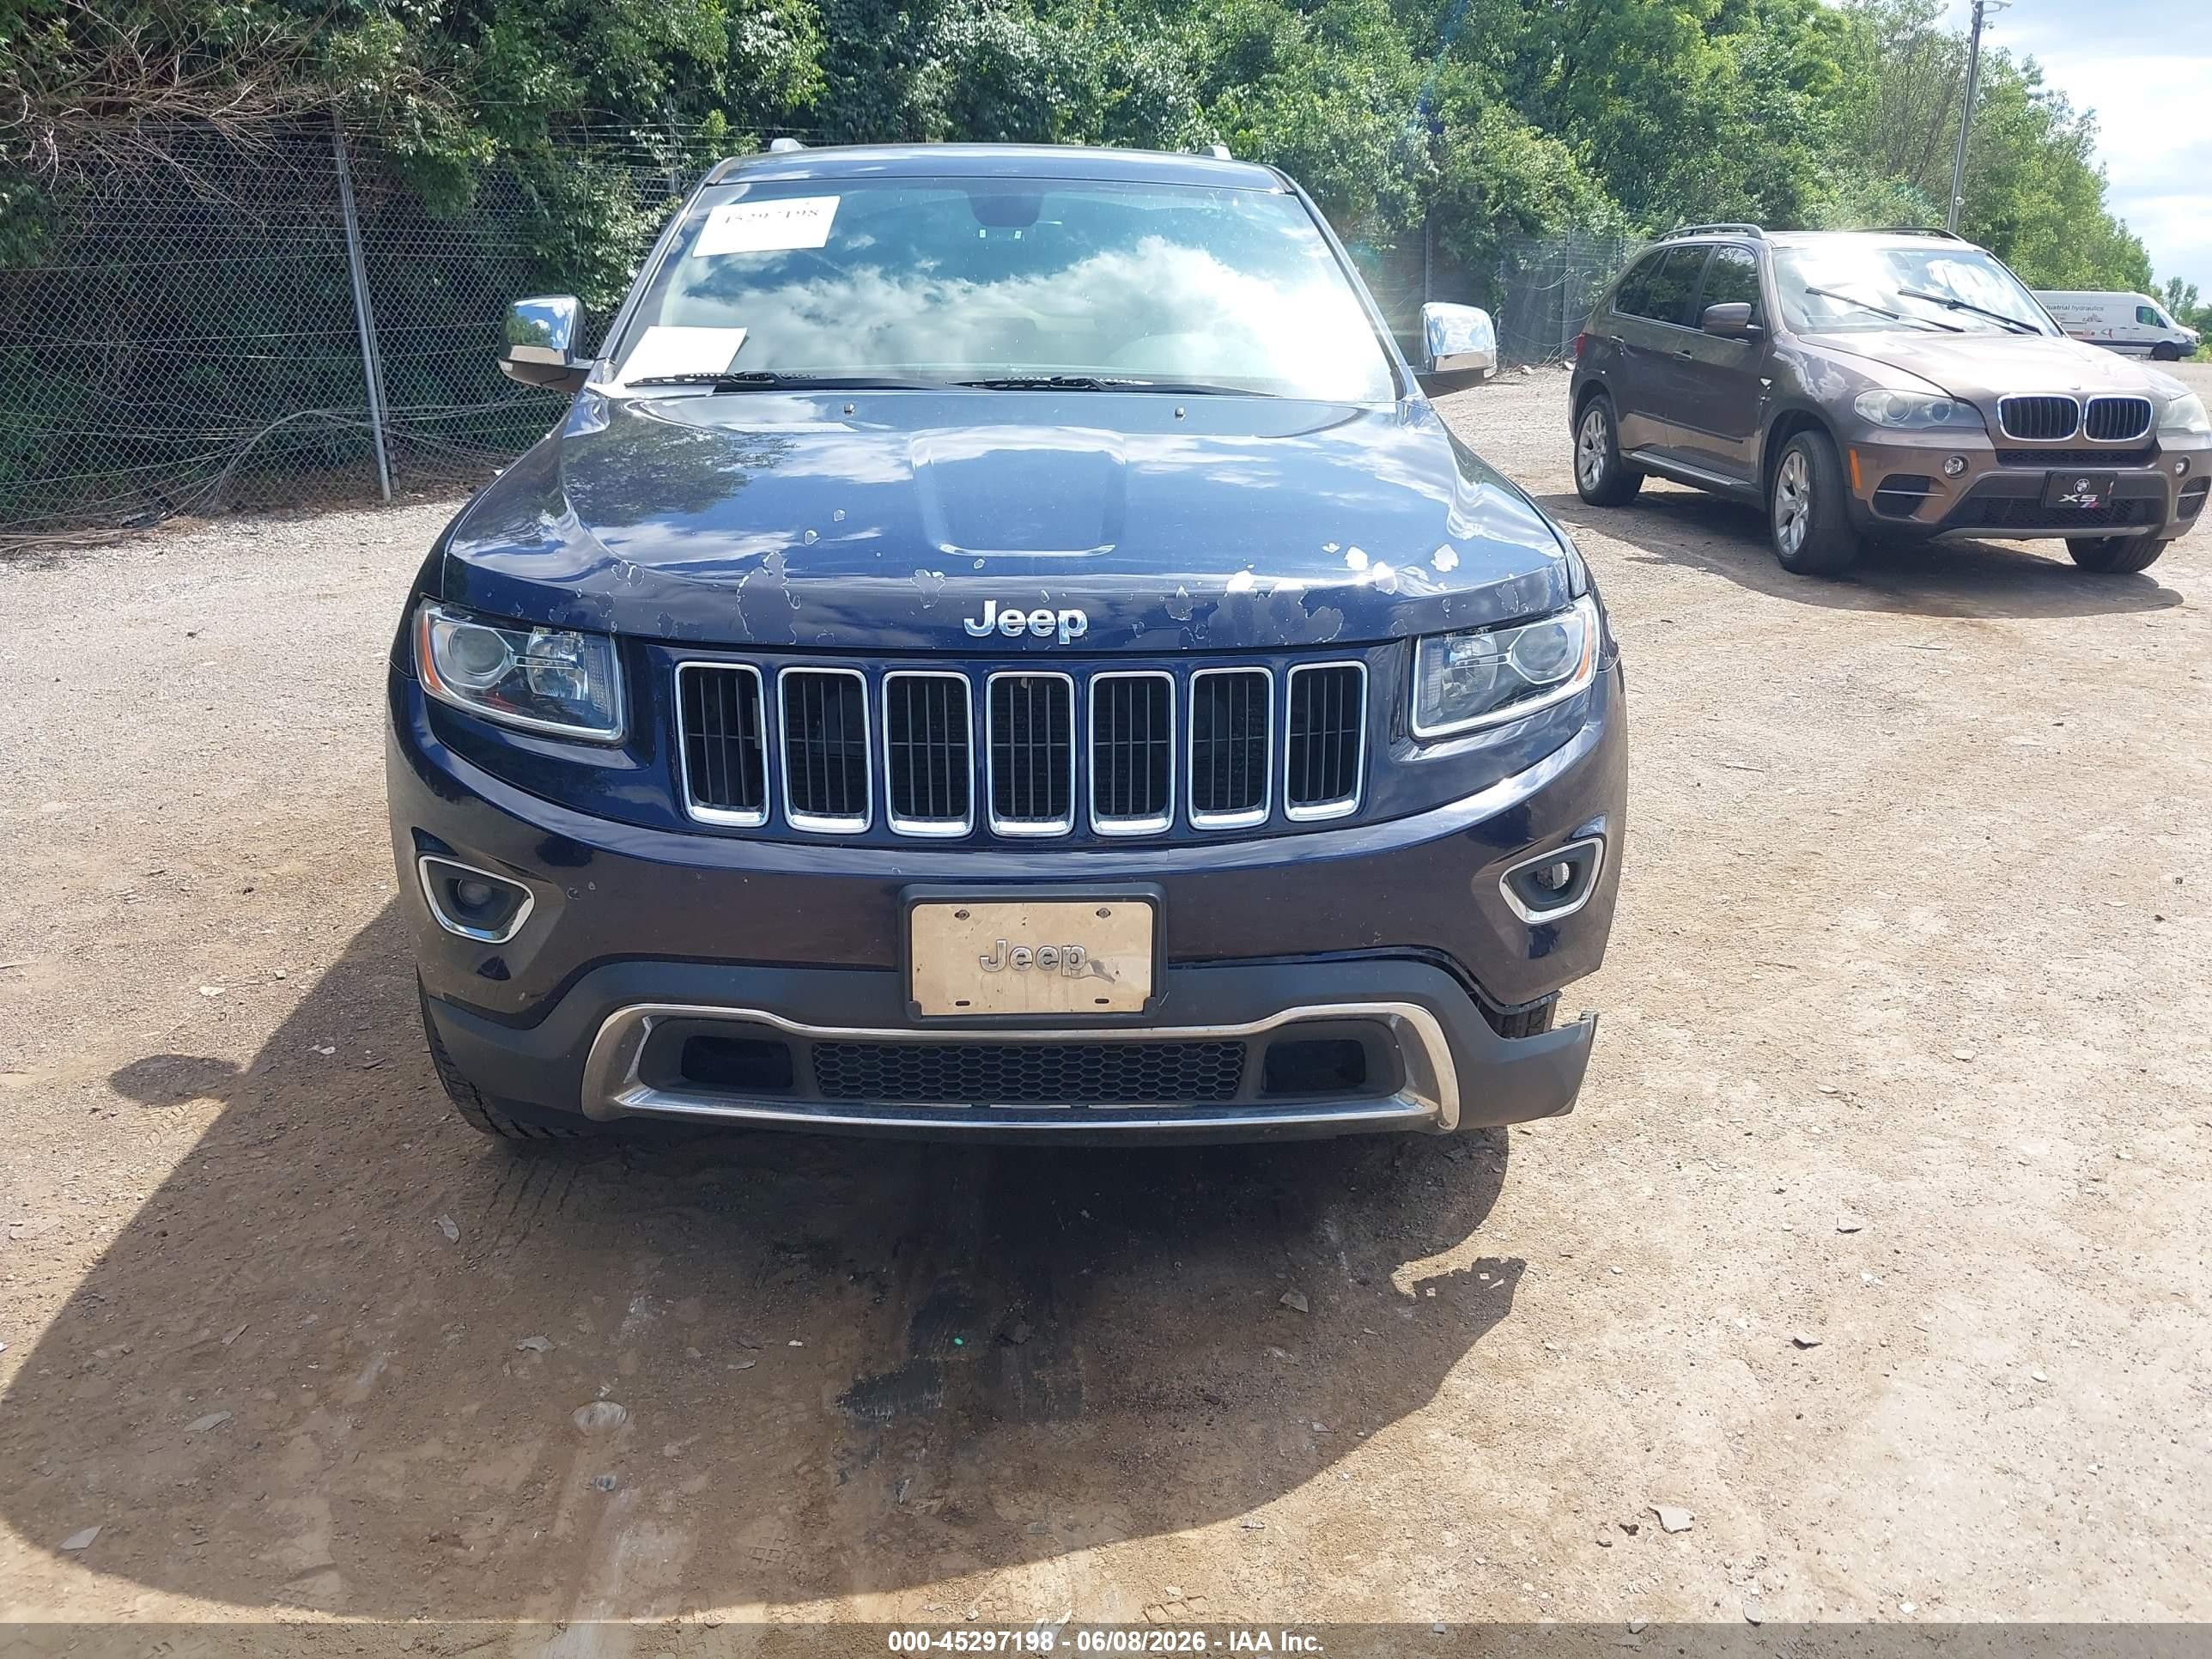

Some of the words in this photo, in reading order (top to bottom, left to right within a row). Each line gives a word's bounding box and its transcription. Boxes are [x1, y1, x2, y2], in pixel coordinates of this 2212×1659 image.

[2057, 494, 2099, 502] X5
[963, 599, 1088, 645] Jeep
[979, 939, 1087, 977] Jeep
